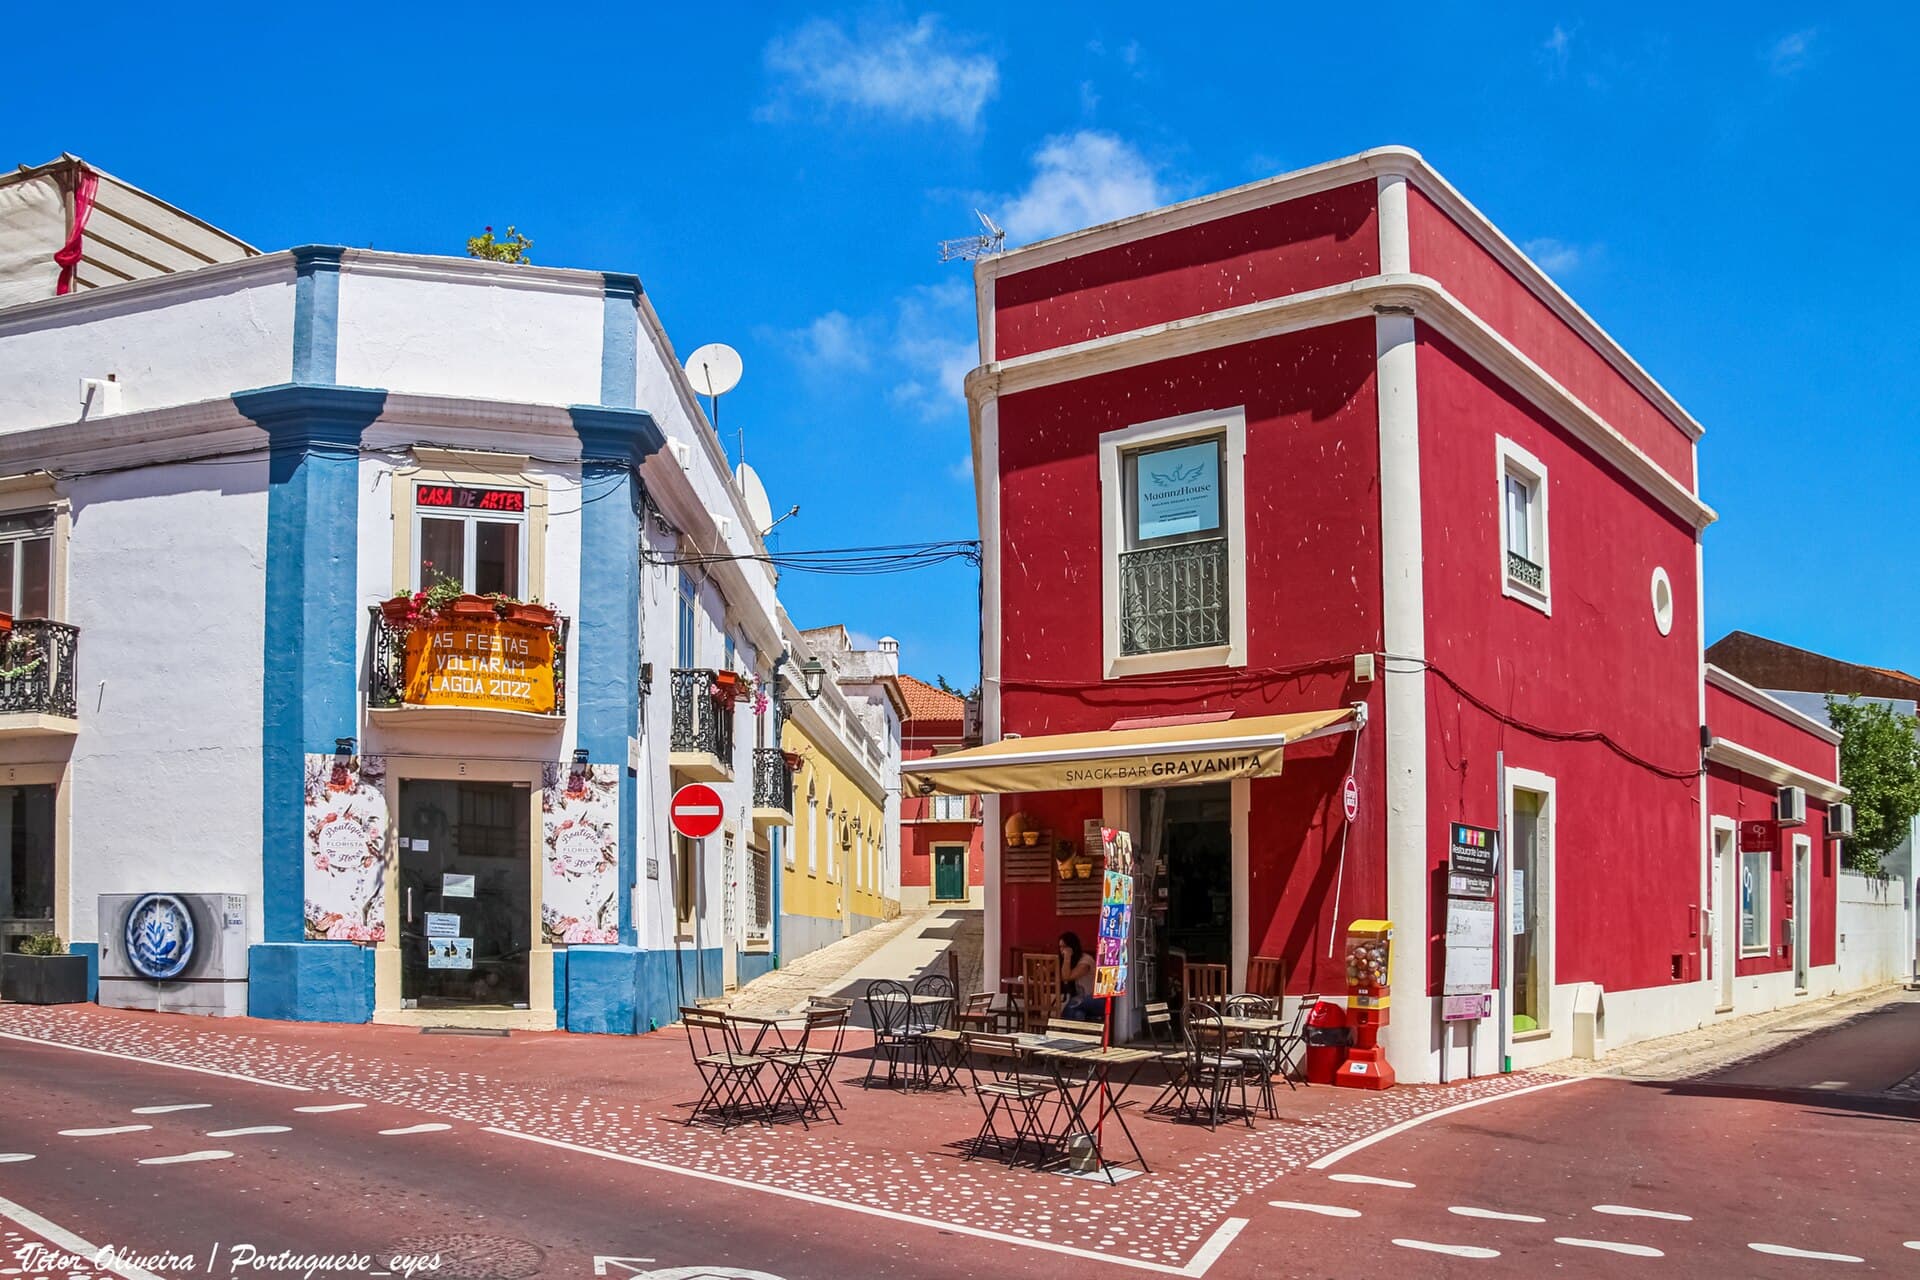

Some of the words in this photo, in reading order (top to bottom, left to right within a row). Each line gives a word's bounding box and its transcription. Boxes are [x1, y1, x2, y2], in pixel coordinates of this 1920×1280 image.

[418, 487, 454, 505] CASA
[458, 490, 478, 507] DE
[480, 491, 523, 510] ARTES
[433, 632, 454, 649] AS
[465, 634, 529, 655] FESTAS
[436, 654, 525, 677] VOLTARAM
[429, 676, 484, 694] LAGOA
[489, 679, 531, 699] 2022
[1066, 766, 1147, 782] SNACK-BAR
[1151, 755, 1262, 776] GRAVANITA
